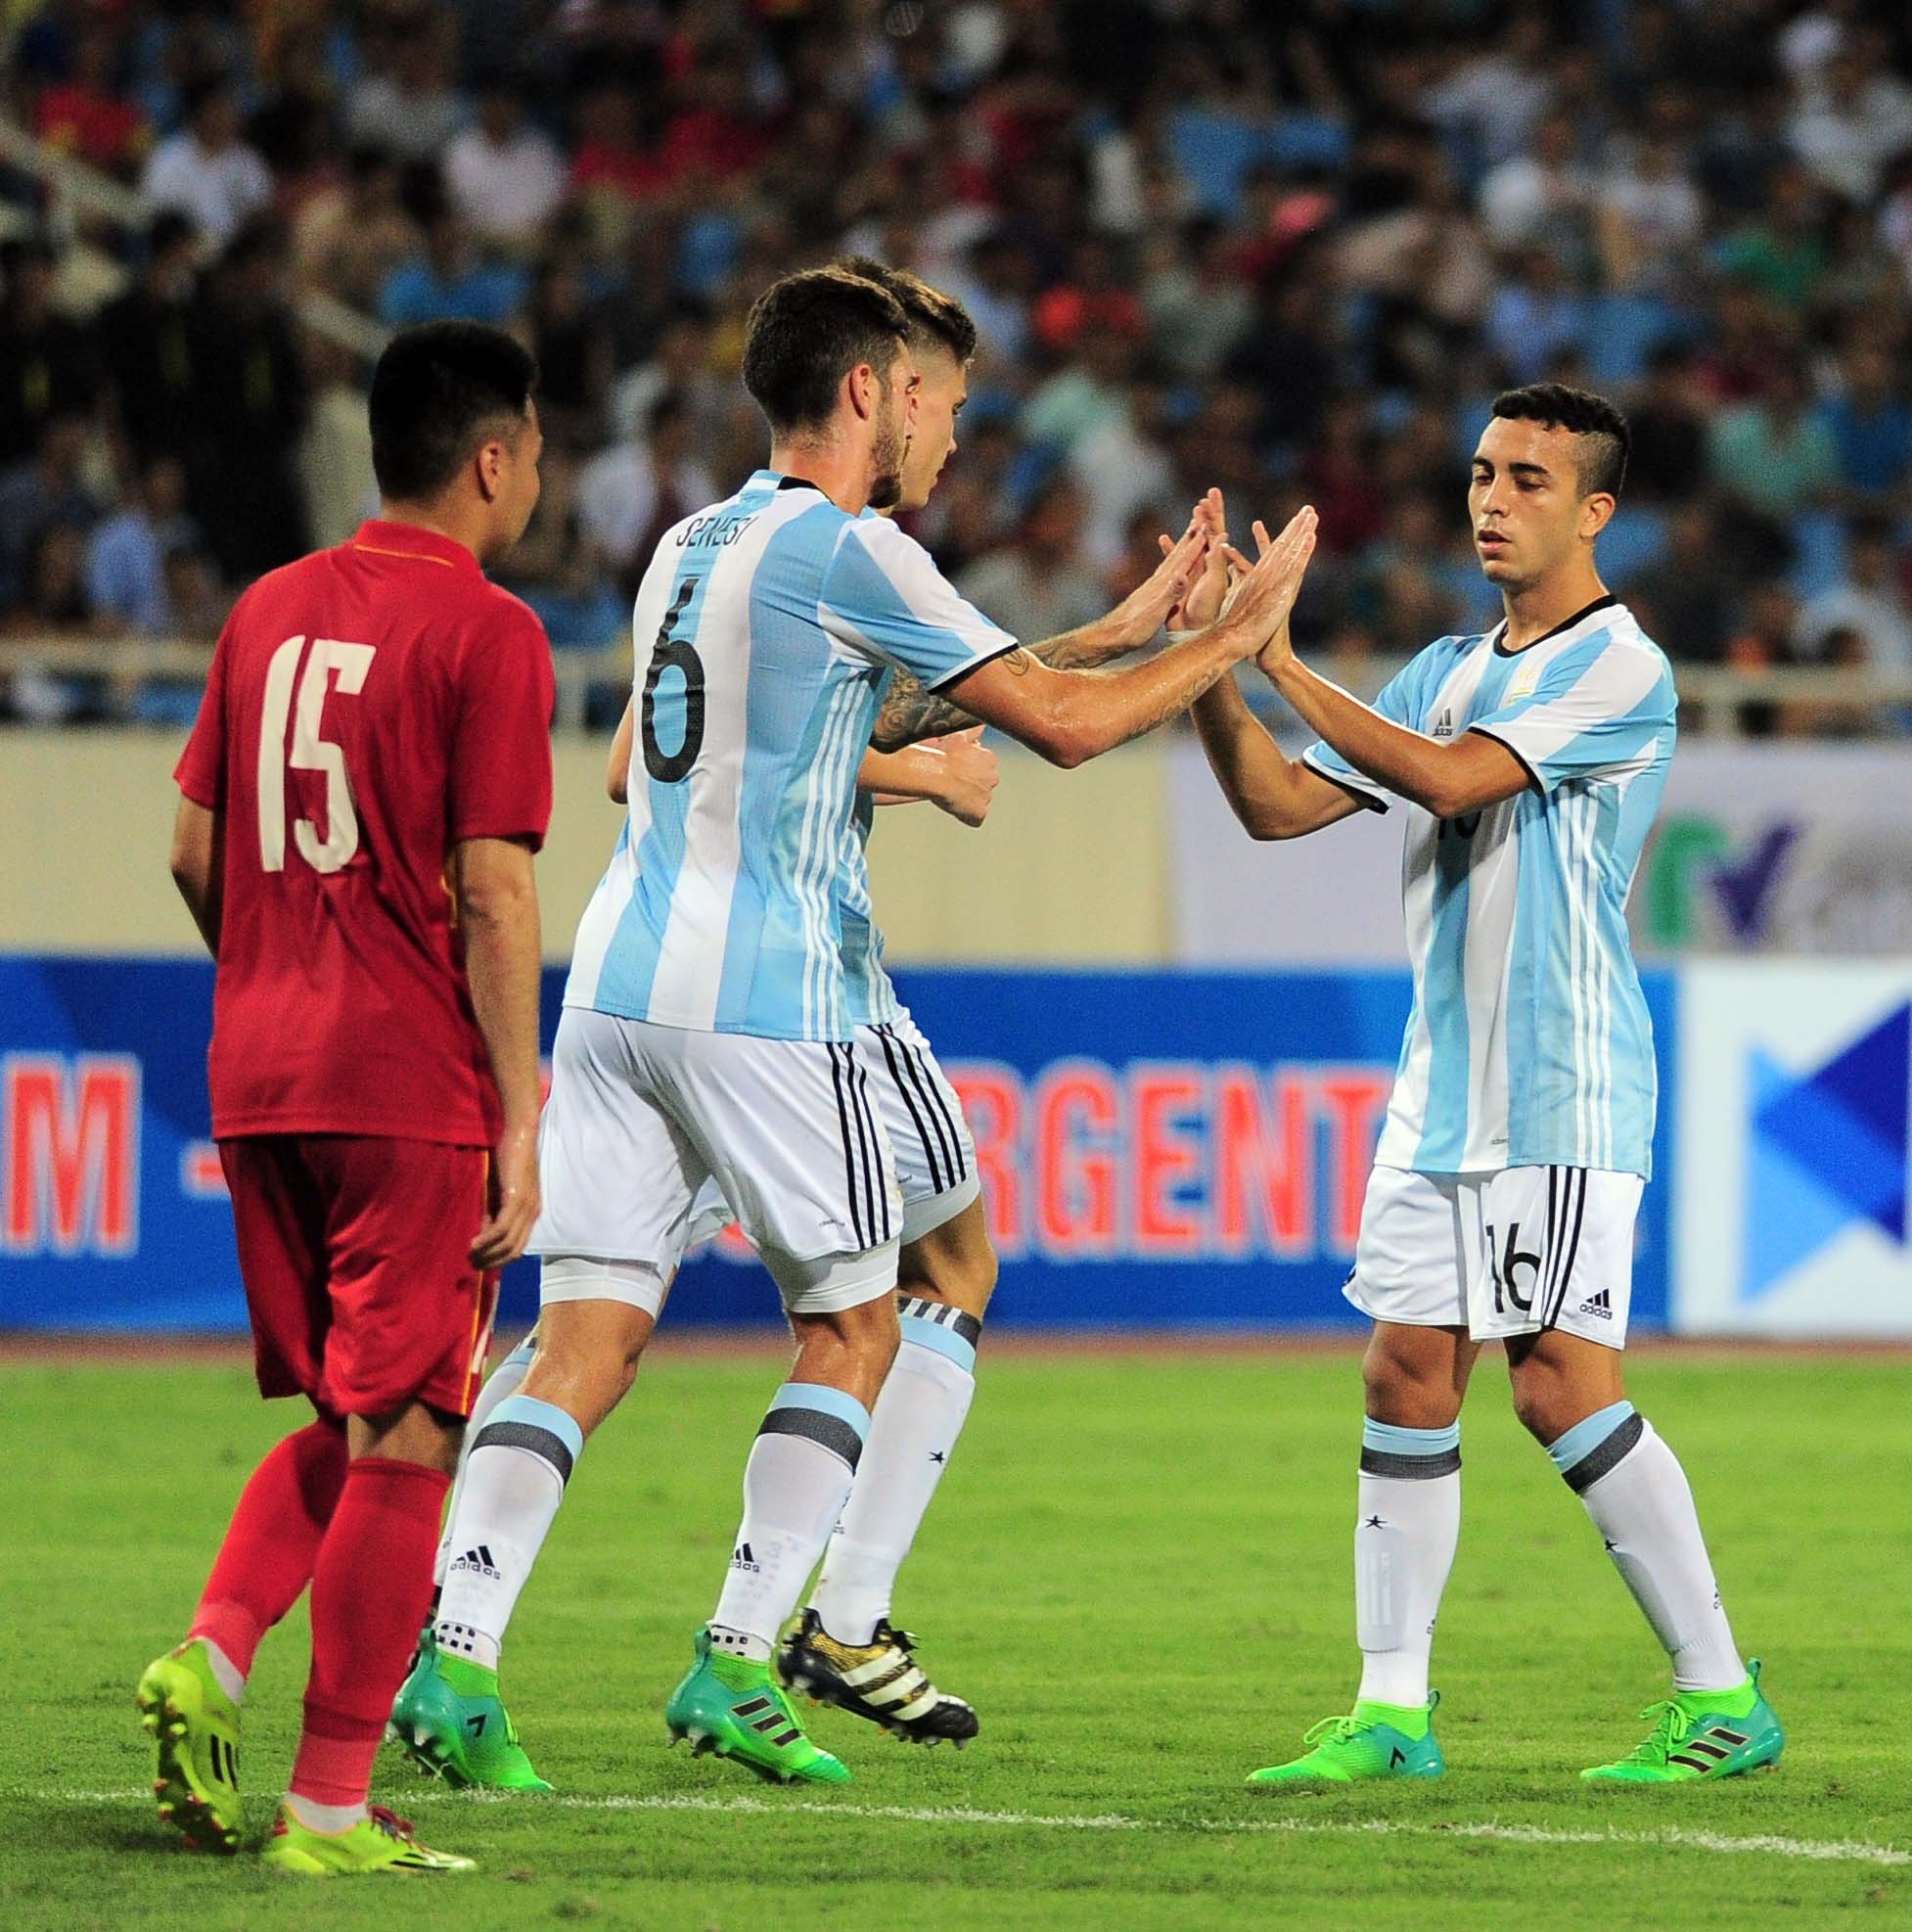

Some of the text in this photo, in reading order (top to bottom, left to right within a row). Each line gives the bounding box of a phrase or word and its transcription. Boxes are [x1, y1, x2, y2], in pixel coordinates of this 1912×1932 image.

[676, 516, 759, 547] SENESI
[258, 635, 376, 873] 15
[642, 578, 705, 782] 6
[936, 1059, 1391, 1259] RGENT
[1485, 1222, 1541, 1312] 16
